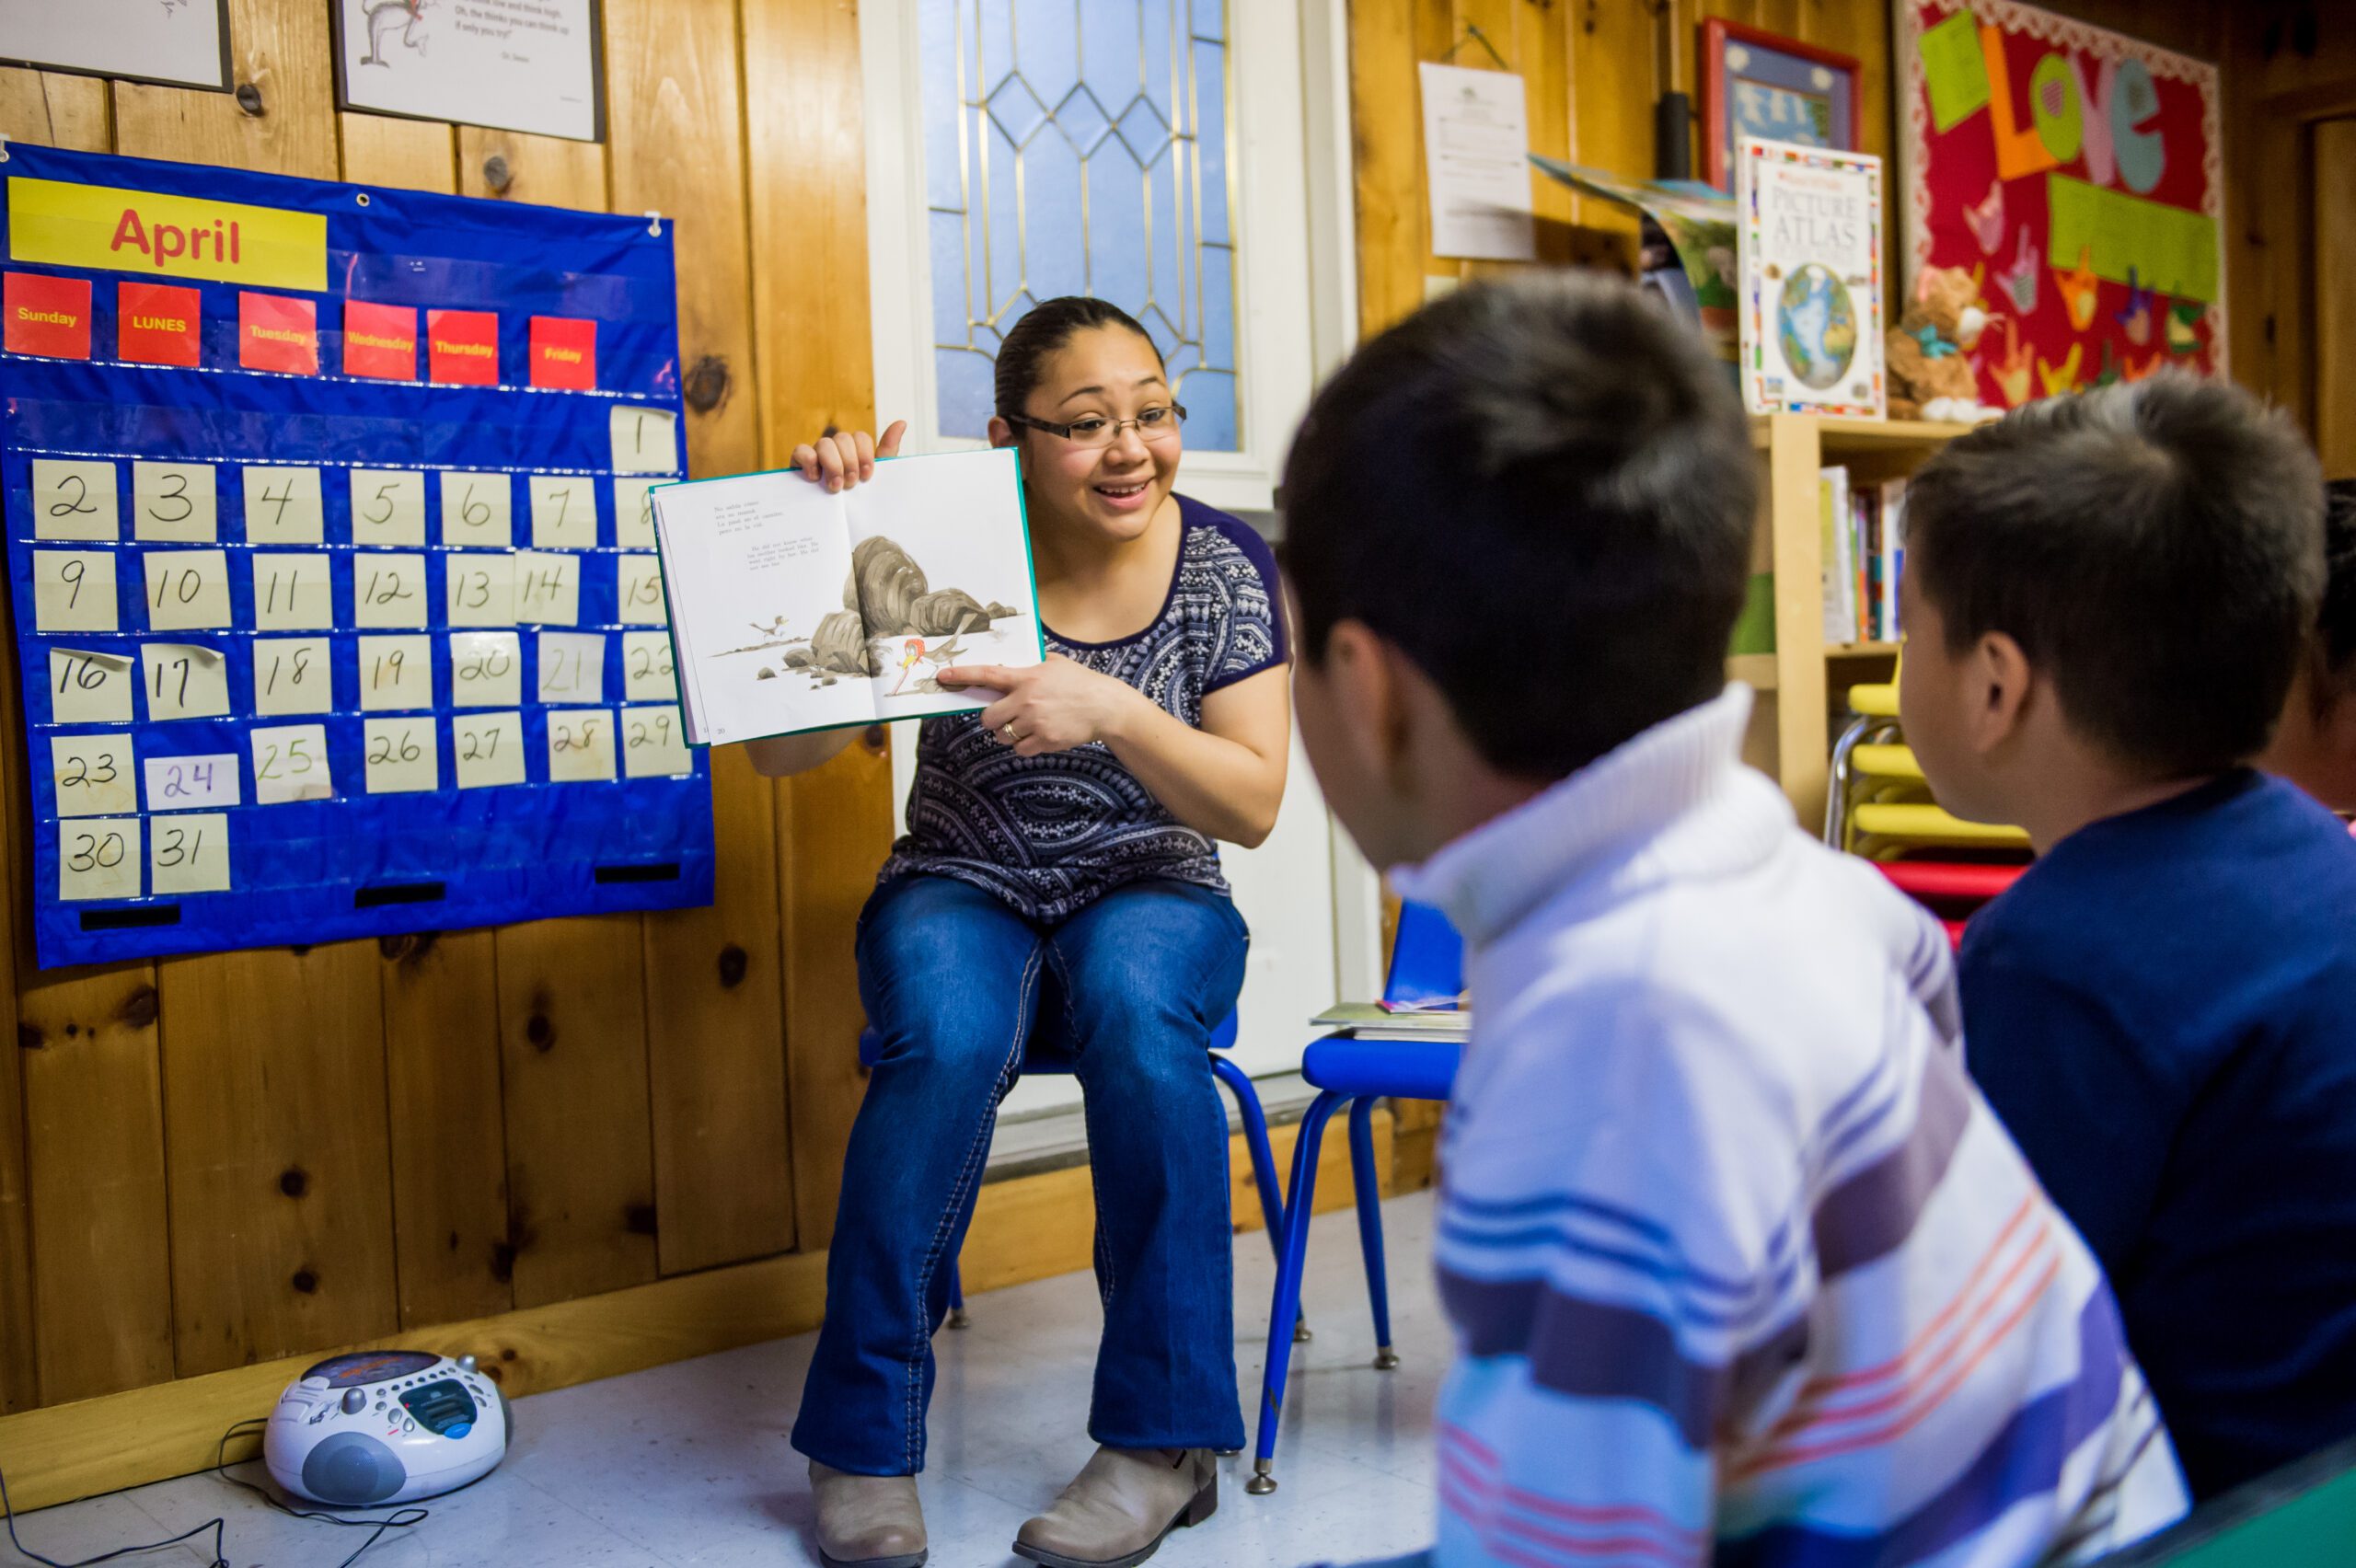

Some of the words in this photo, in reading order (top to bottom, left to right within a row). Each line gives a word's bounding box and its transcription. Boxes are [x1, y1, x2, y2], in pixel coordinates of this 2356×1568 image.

[469, 8, 482, 18] the
[1773, 185, 1858, 219] PICTURE
[110, 208, 239, 267] April
[1773, 213, 1857, 251] ATLAS
[18, 307, 77, 328] Sunday
[133, 316, 187, 332] LUNES
[250, 325, 307, 346] Tuesday
[348, 331, 414, 352] Wednesday
[435, 340, 494, 359] Thursday
[545, 347, 583, 364] Friday
[636, 415, 643, 455] 1
[50, 475, 98, 516] 2
[148, 474, 192, 523] 3
[261, 478, 293, 525] 4
[361, 483, 400, 525] 5
[462, 482, 491, 527] 6
[549, 488, 571, 528] 7
[61, 559, 85, 609] 9
[156, 569, 201, 608] 10
[266, 570, 297, 614] 11
[364, 571, 413, 605] 12
[456, 571, 491, 608] 13
[523, 566, 563, 604] 14
[627, 575, 662, 607] 15
[60, 656, 107, 694] 16
[155, 658, 190, 709] 17
[267, 647, 312, 696] 18
[373, 650, 405, 690] 19
[459, 650, 511, 680] 20
[542, 648, 582, 691] 21
[630, 645, 675, 680] 22
[62, 754, 117, 788] 23
[164, 762, 213, 799] 24
[257, 739, 313, 782] 25
[368, 730, 421, 765] 26
[462, 728, 501, 761] 27
[553, 719, 601, 753] 28
[629, 714, 671, 749] 29
[68, 832, 125, 872] 30
[157, 828, 202, 867] 31
